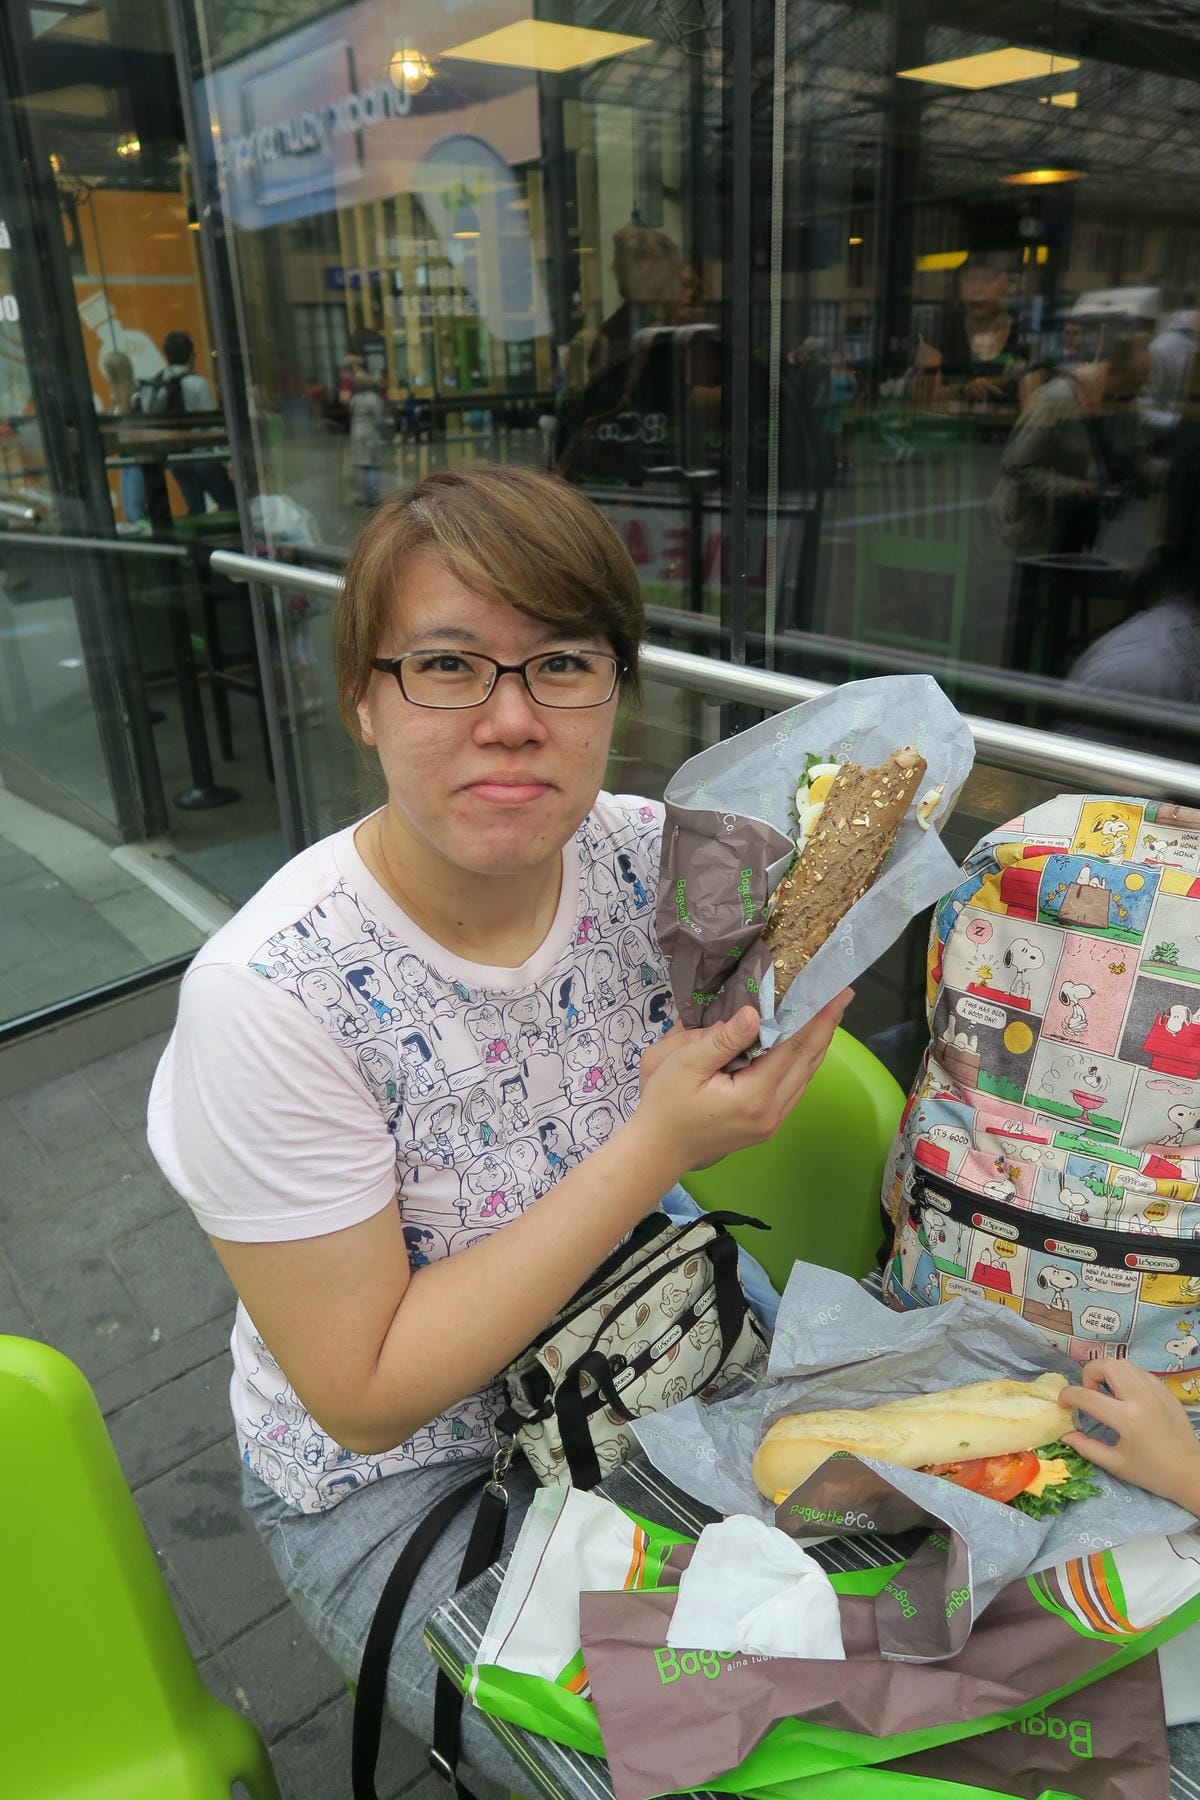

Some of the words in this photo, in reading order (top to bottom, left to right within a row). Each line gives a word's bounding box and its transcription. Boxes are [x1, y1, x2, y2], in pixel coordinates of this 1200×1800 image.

[1173, 850, 1195, 859] HONK
[965, 1000, 977, 1009] THIS
[979, 1005, 990, 1013] HAS
[933, 1128, 947, 1138] IT'S
[949, 1132, 969, 1145] GOOD
